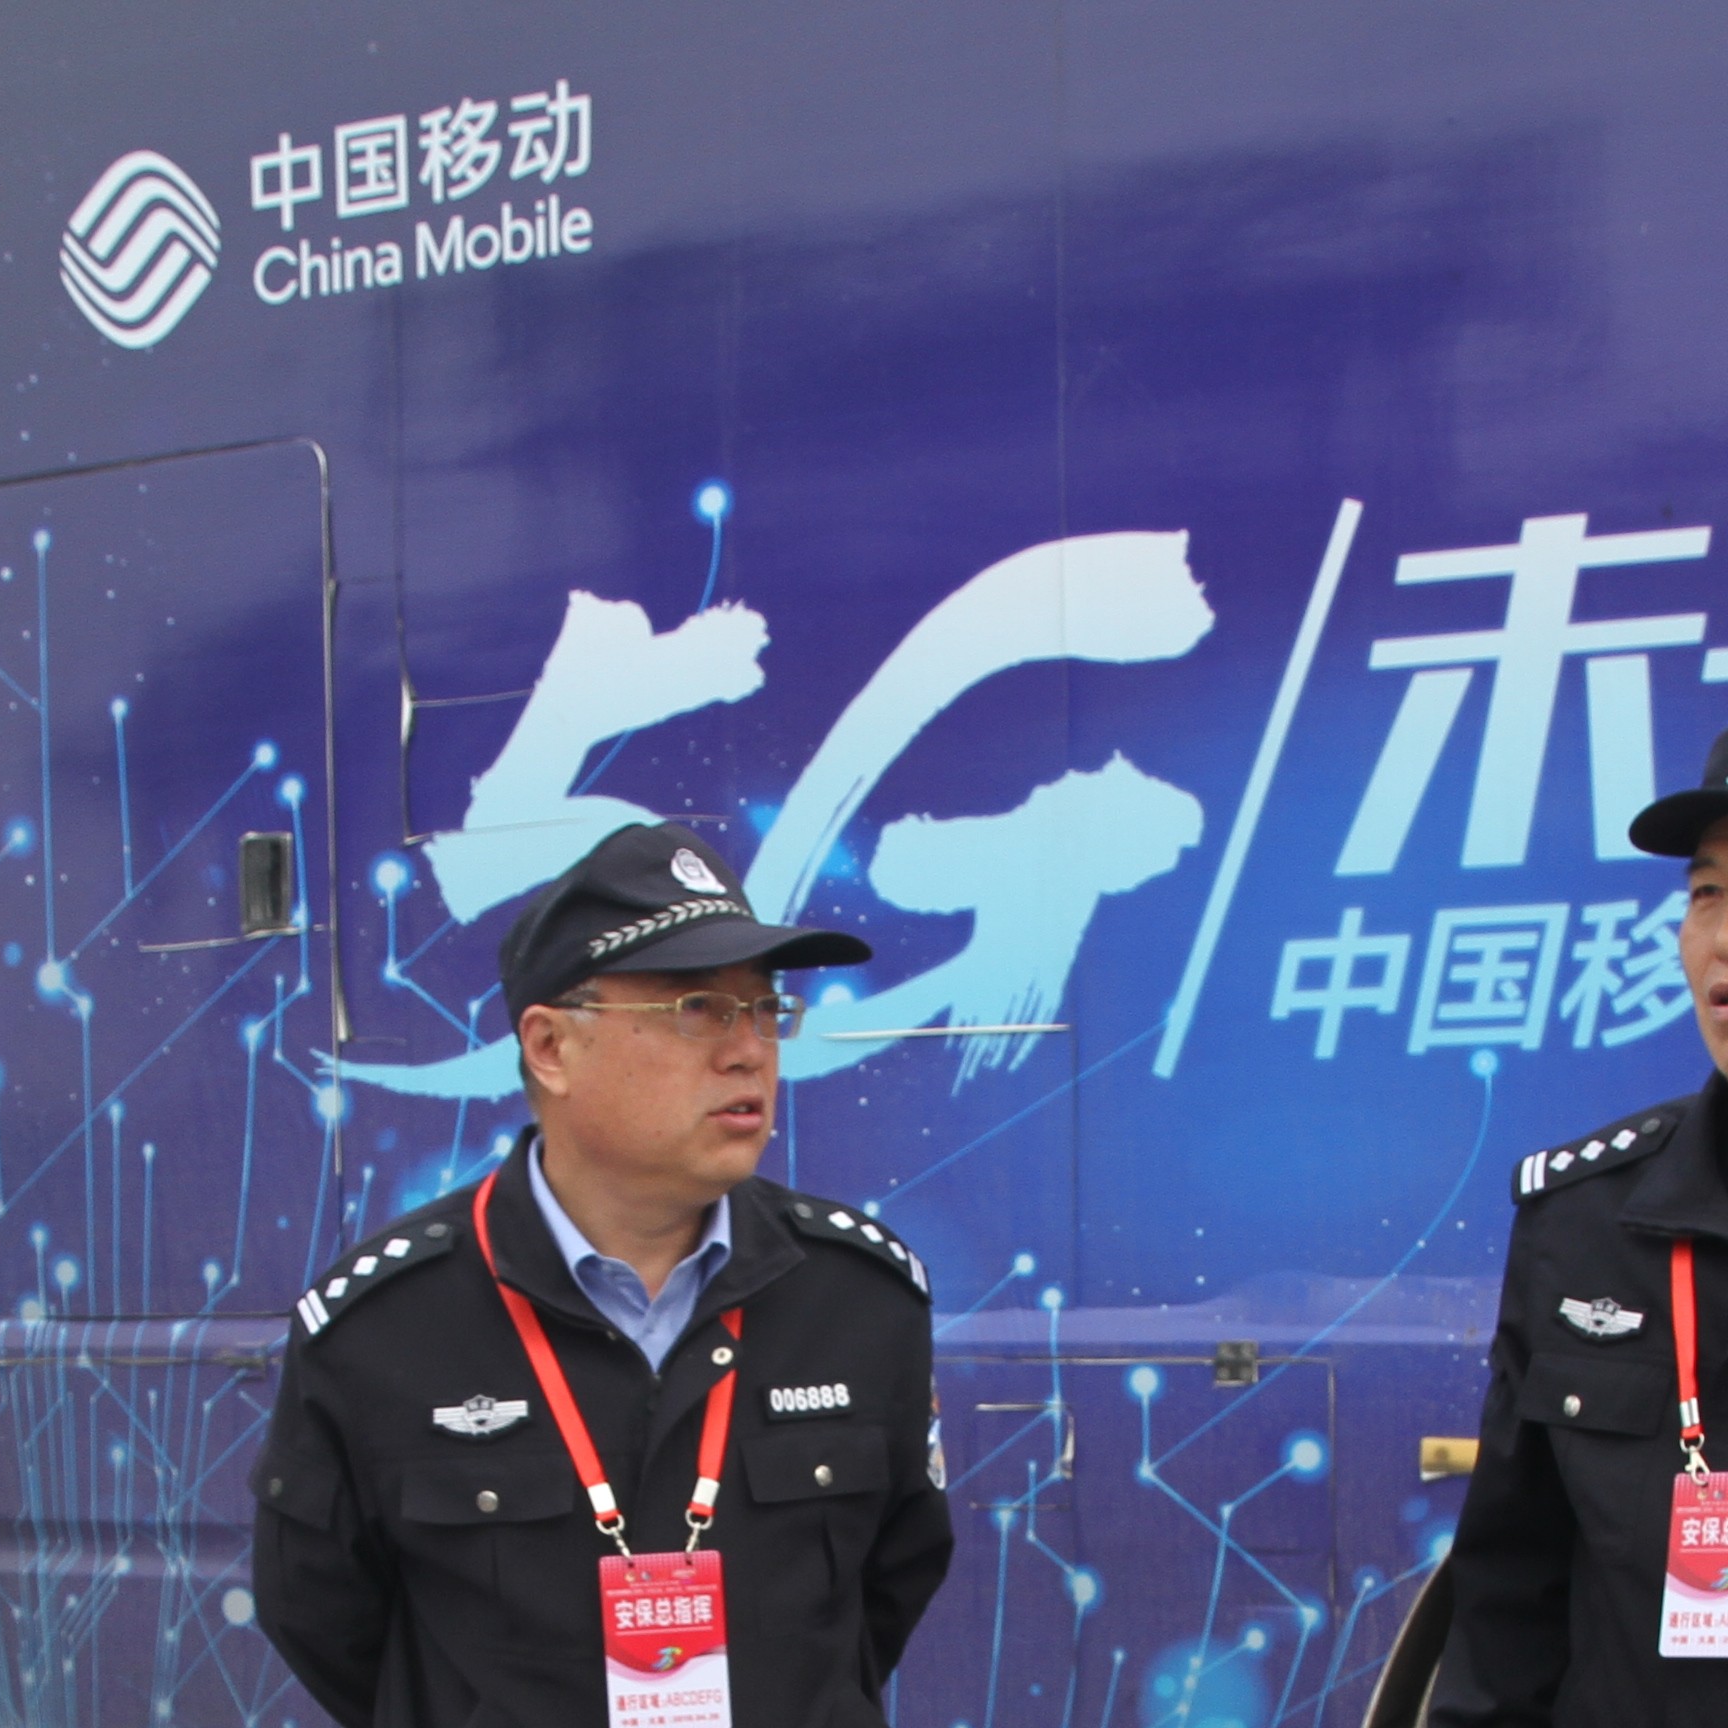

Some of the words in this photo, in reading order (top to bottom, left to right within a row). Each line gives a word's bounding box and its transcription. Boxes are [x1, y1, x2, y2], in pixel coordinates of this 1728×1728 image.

[250, 78, 592, 231] 中国移动
[252, 236, 403, 305] China
[415, 193, 593, 280] Mobile
[1272, 892, 1696, 1060] 中国移
[770, 1383, 851, 1412] 006888
[614, 1593, 714, 1630] 安保总指挥
